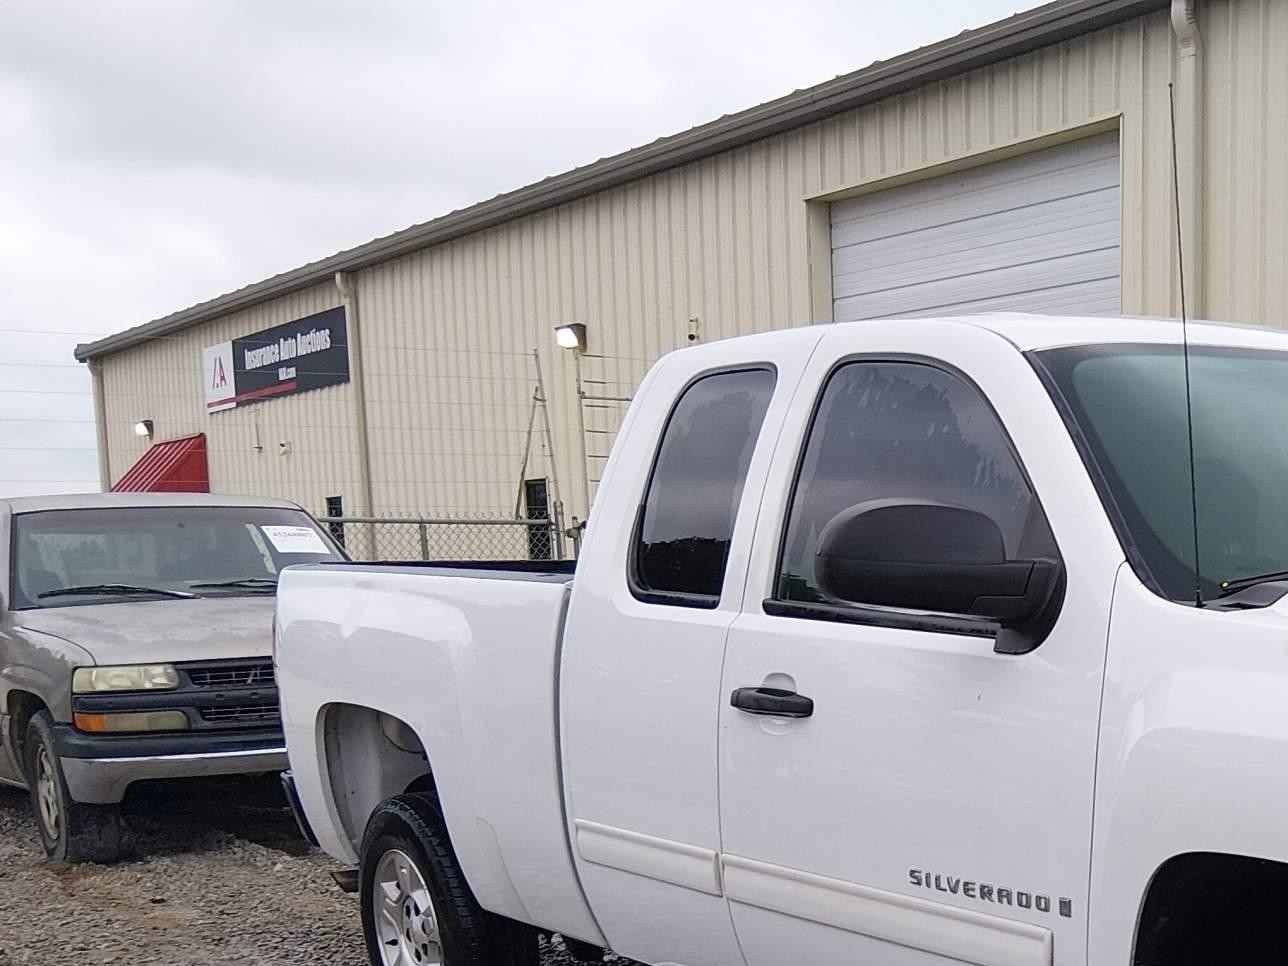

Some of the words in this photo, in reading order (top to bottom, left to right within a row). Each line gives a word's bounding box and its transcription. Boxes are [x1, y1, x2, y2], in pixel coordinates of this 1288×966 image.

[244, 343, 280, 370] Insurance
[279, 337, 297, 361] Auto
[297, 328, 331, 357] Auctions
[908, 868, 1051, 913] SILVERADO
